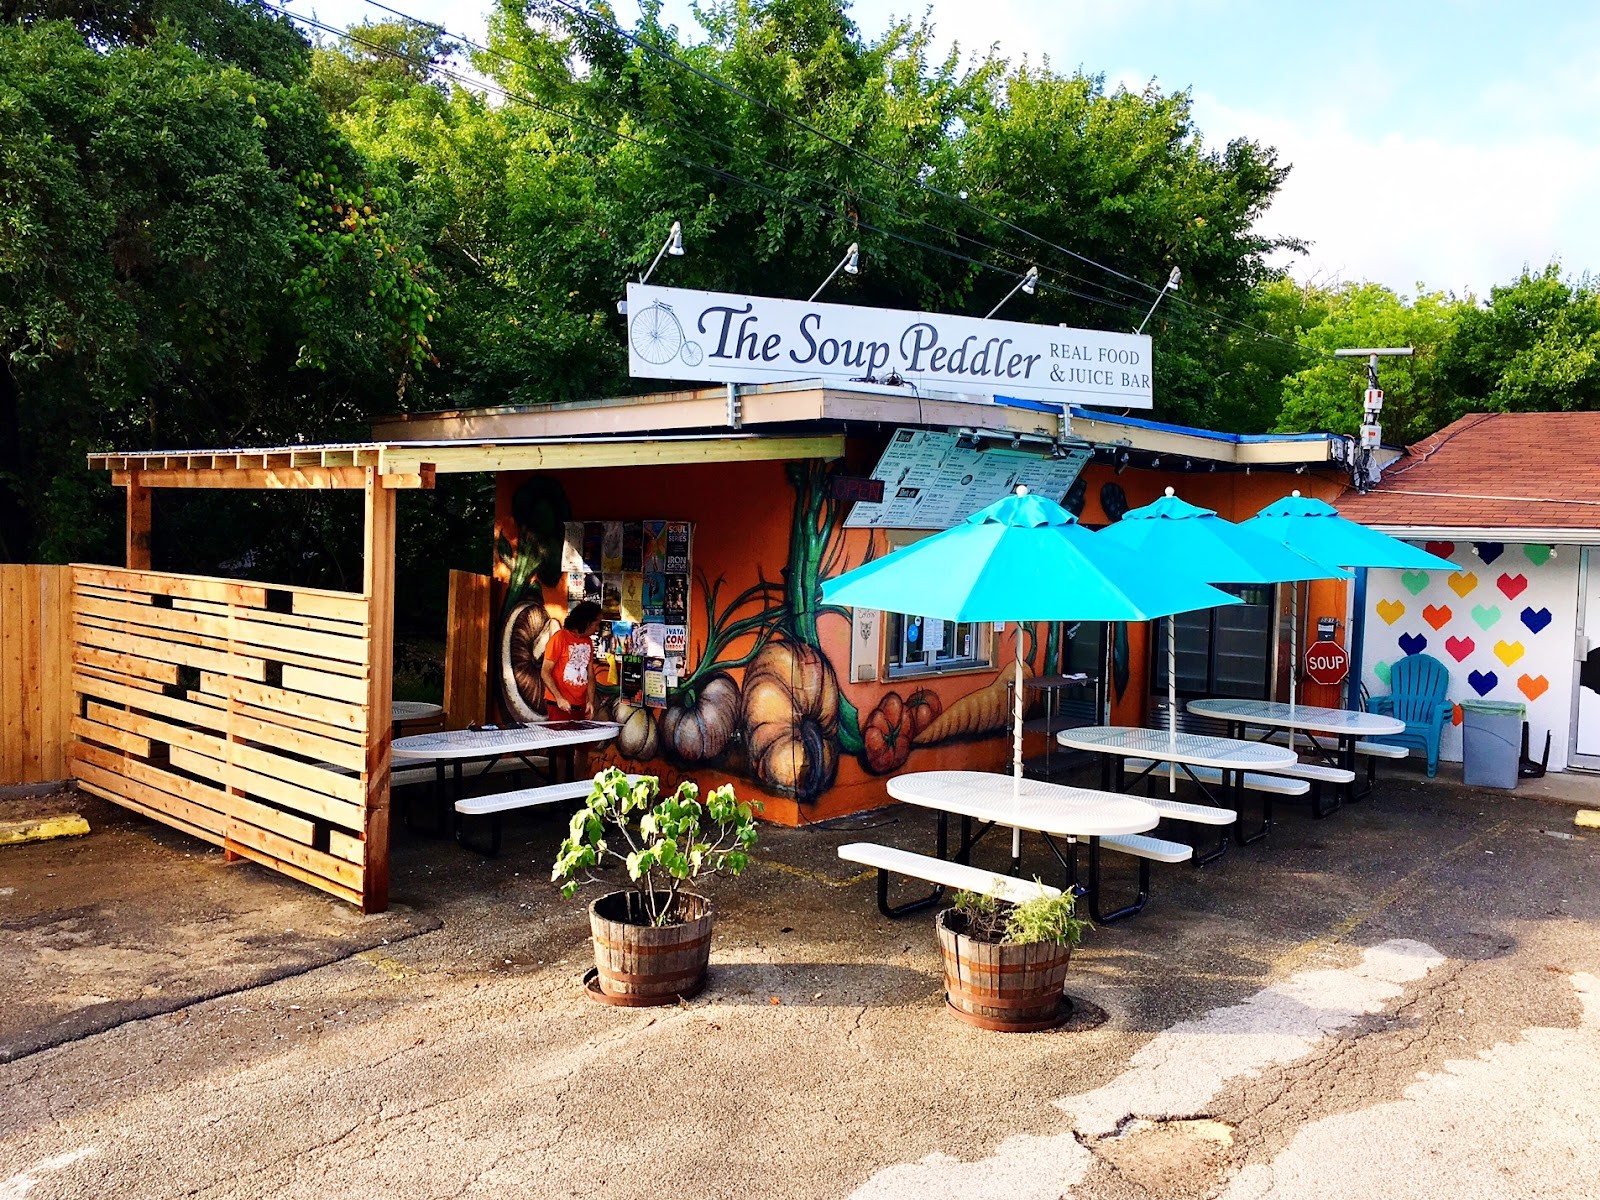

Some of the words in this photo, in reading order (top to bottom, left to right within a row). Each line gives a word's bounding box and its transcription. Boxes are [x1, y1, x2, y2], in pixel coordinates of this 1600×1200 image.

[697, 302, 782, 362] The
[789, 313, 890, 380] Soup
[899, 322, 1042, 379] Peddler
[1049, 342, 1093, 361] REAL
[1098, 347, 1140, 365] FOOD
[1049, 363, 1066, 383] &
[1068, 367, 1114, 386] JUICE
[1121, 372, 1151, 389] BAR
[834, 478, 883, 501] OPEN
[667, 555, 687, 564] IRON
[1308, 655, 1345, 670] SOUP
